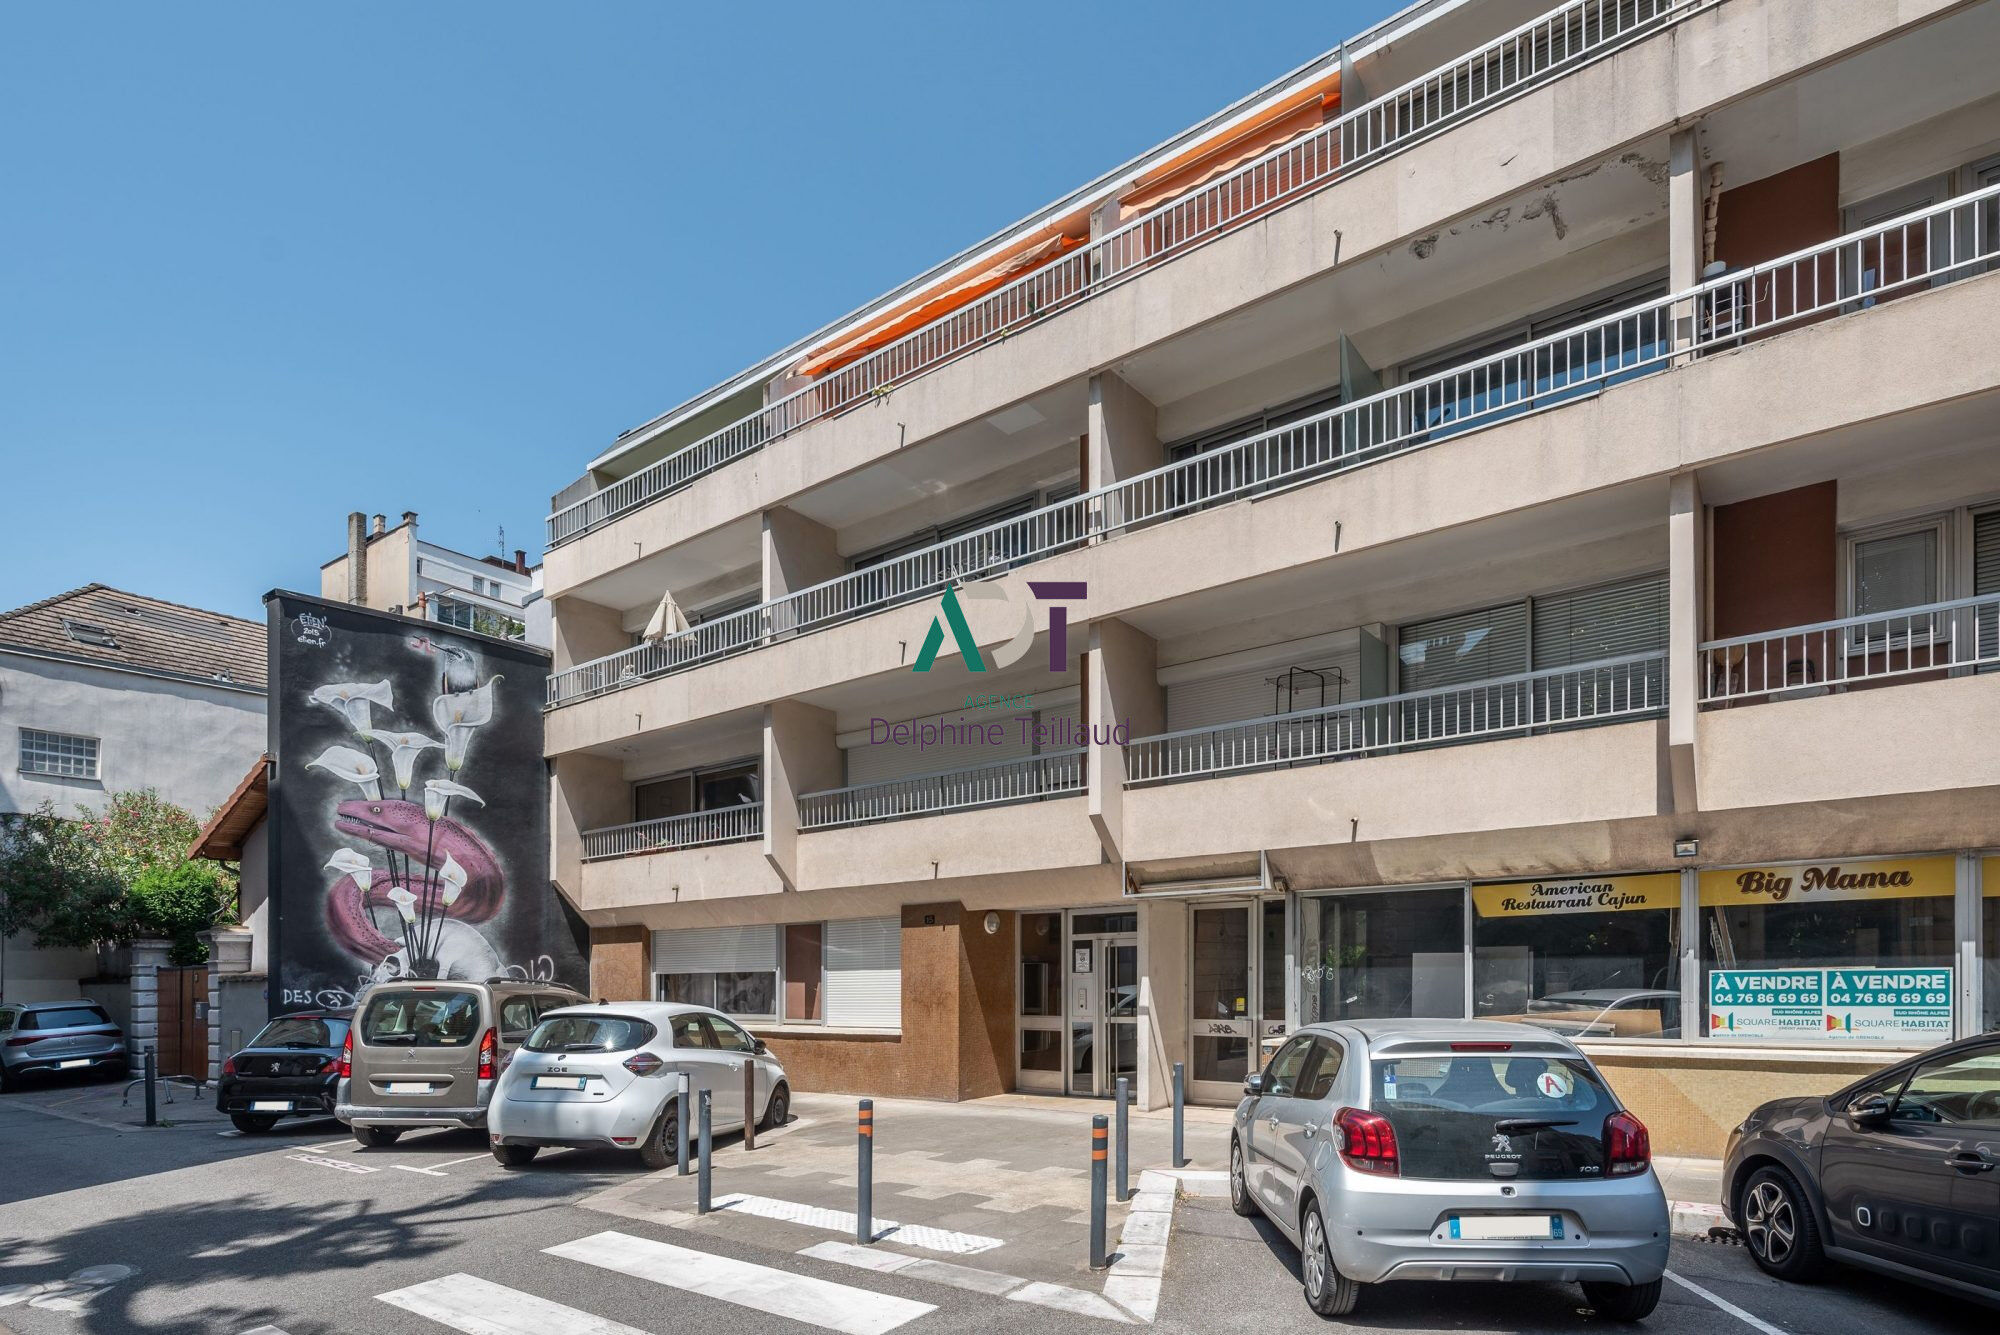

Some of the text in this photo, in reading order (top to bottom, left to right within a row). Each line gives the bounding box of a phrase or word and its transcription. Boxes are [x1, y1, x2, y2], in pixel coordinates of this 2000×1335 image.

[1530, 881, 1615, 896] American
[1736, 866, 1913, 901] Big Mama
[1501, 892, 1648, 911] Restaurant Cajun
[1715, 973, 1818, 990] À VENDRE
[1831, 971, 1945, 989] À VENDRE
[283, 989, 312, 1005] DES
[1715, 993, 1819, 1003] 04 76 86 69 69
[1830, 993, 1946, 1003] 04 76 86 69 69
[1553, 1228, 1563, 1237] 69
